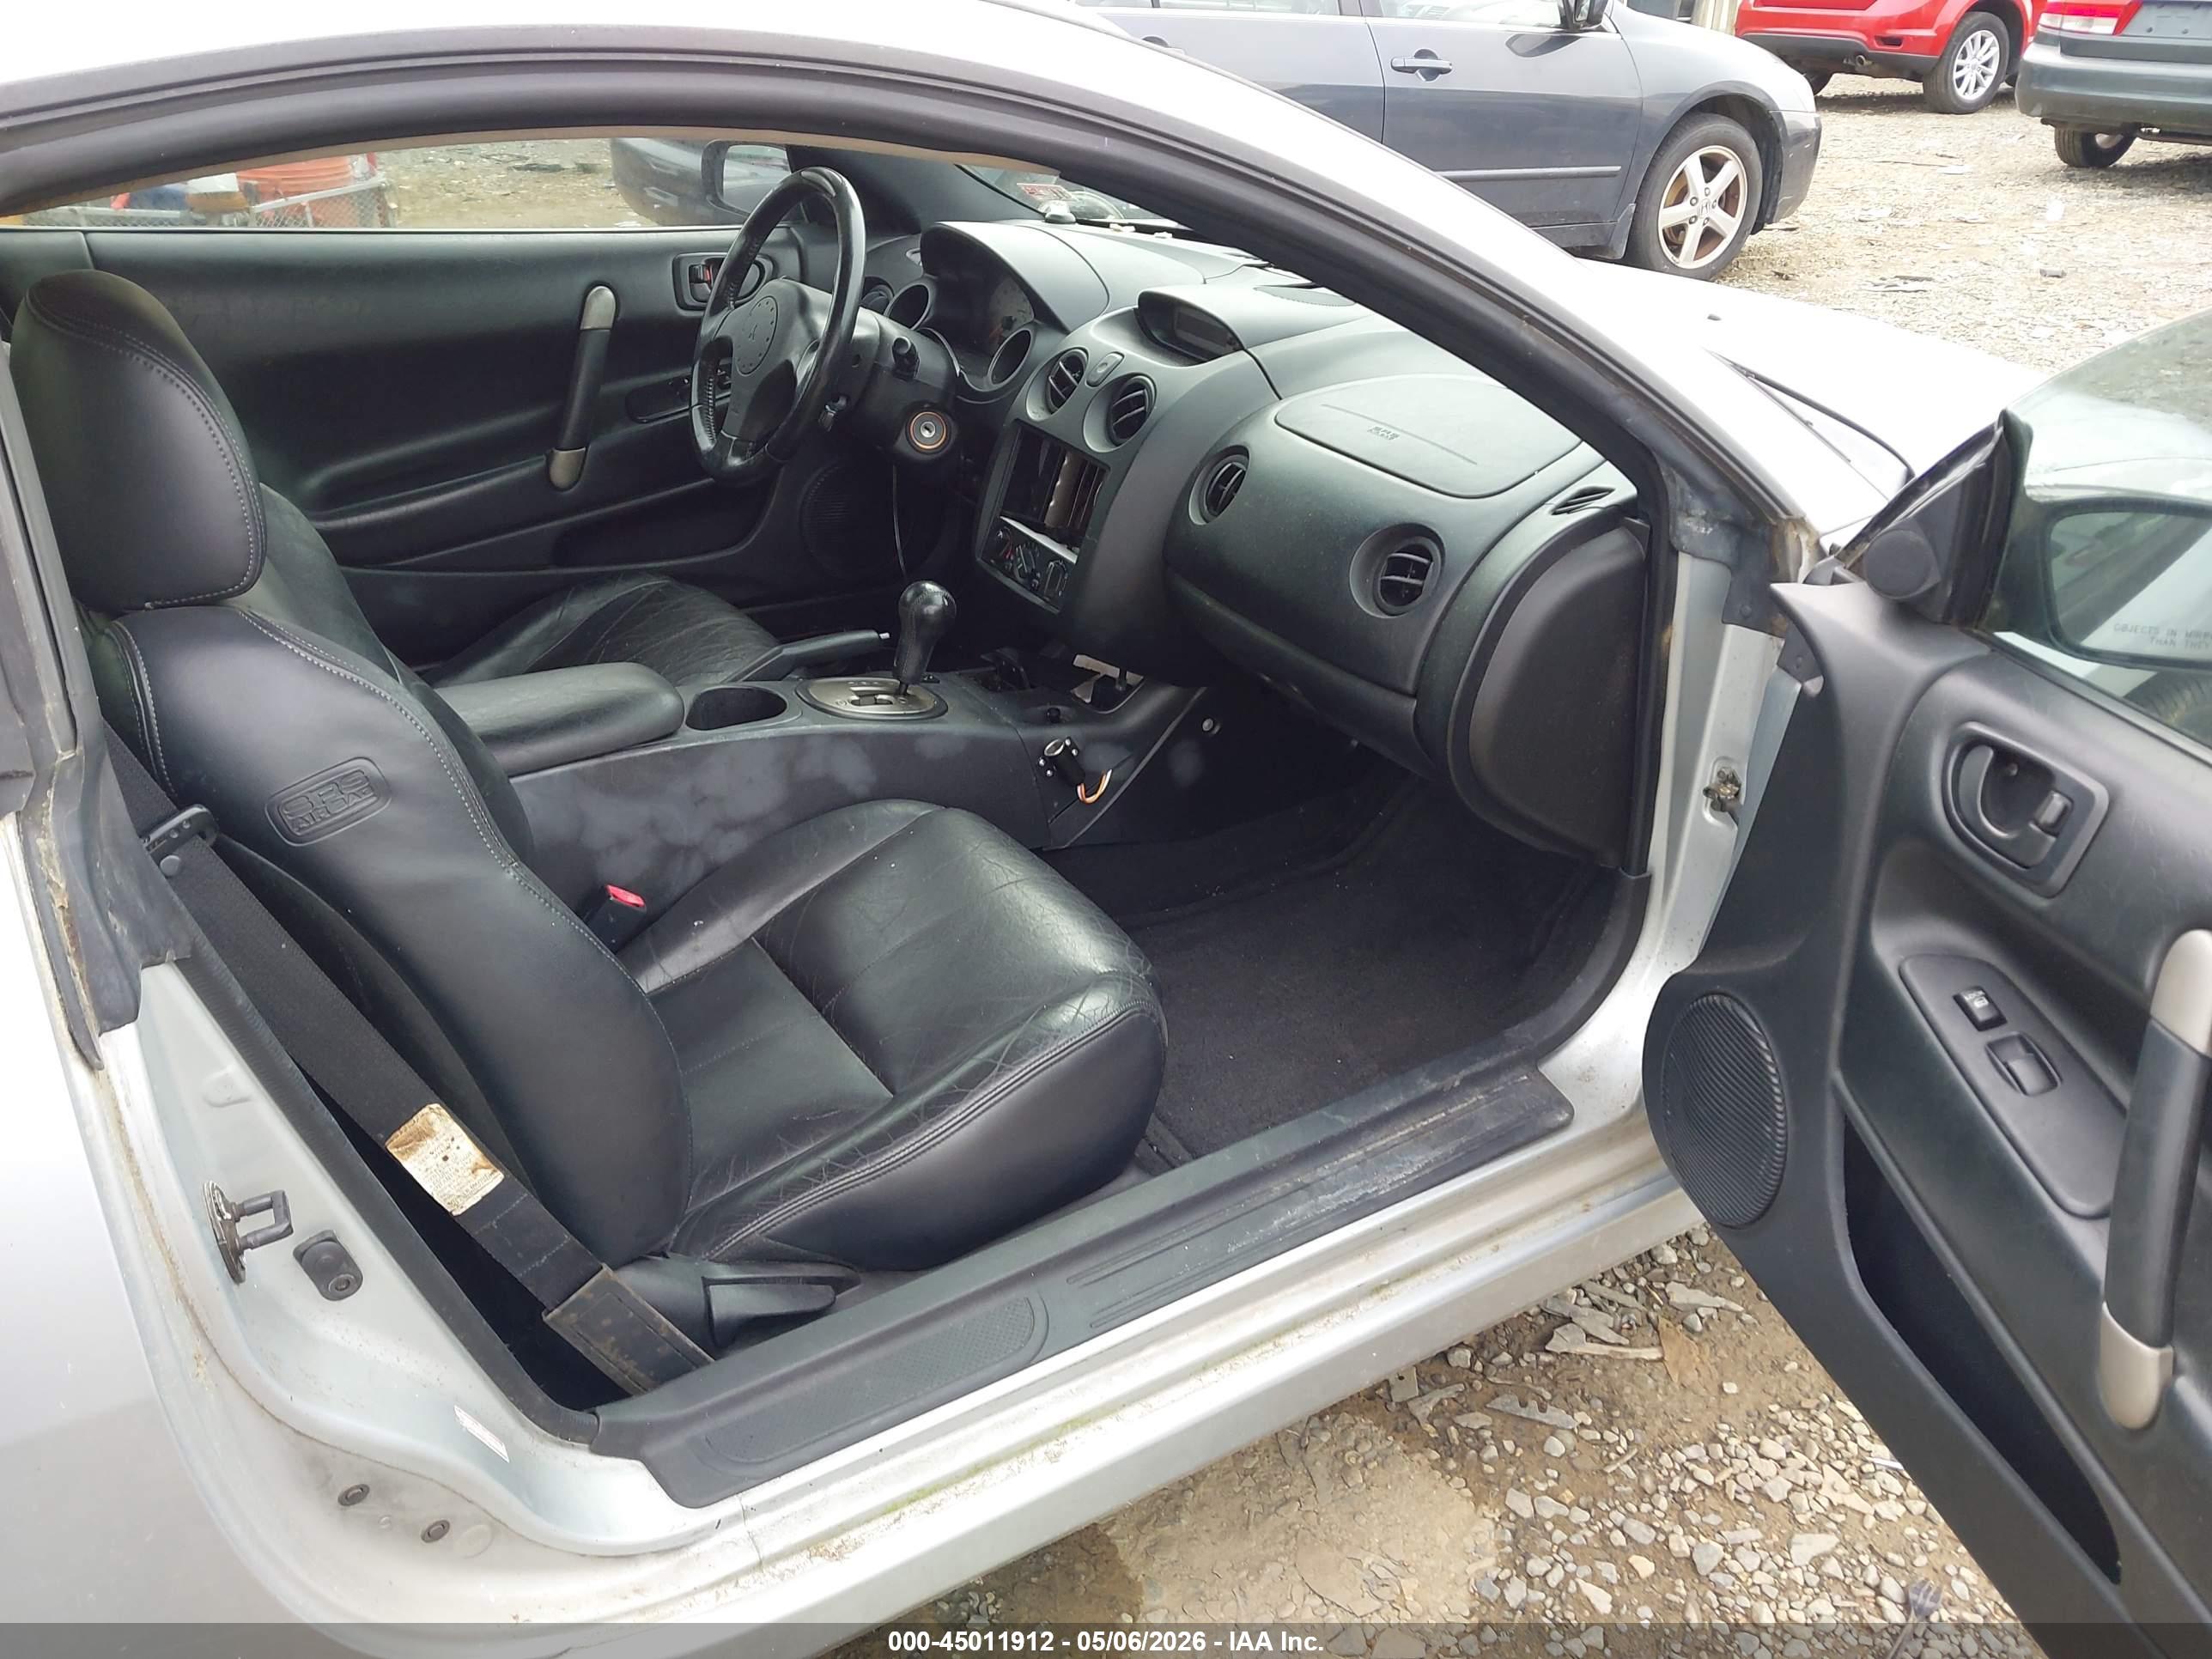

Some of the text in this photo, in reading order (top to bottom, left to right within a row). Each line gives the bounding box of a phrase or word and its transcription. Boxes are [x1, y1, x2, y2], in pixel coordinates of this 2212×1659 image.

[2113, 623, 2160, 635] OBJECTS
[2184, 629, 2212, 640] MIRR
[2149, 635, 2176, 647] THAN
[282, 769, 371, 818] SRS
